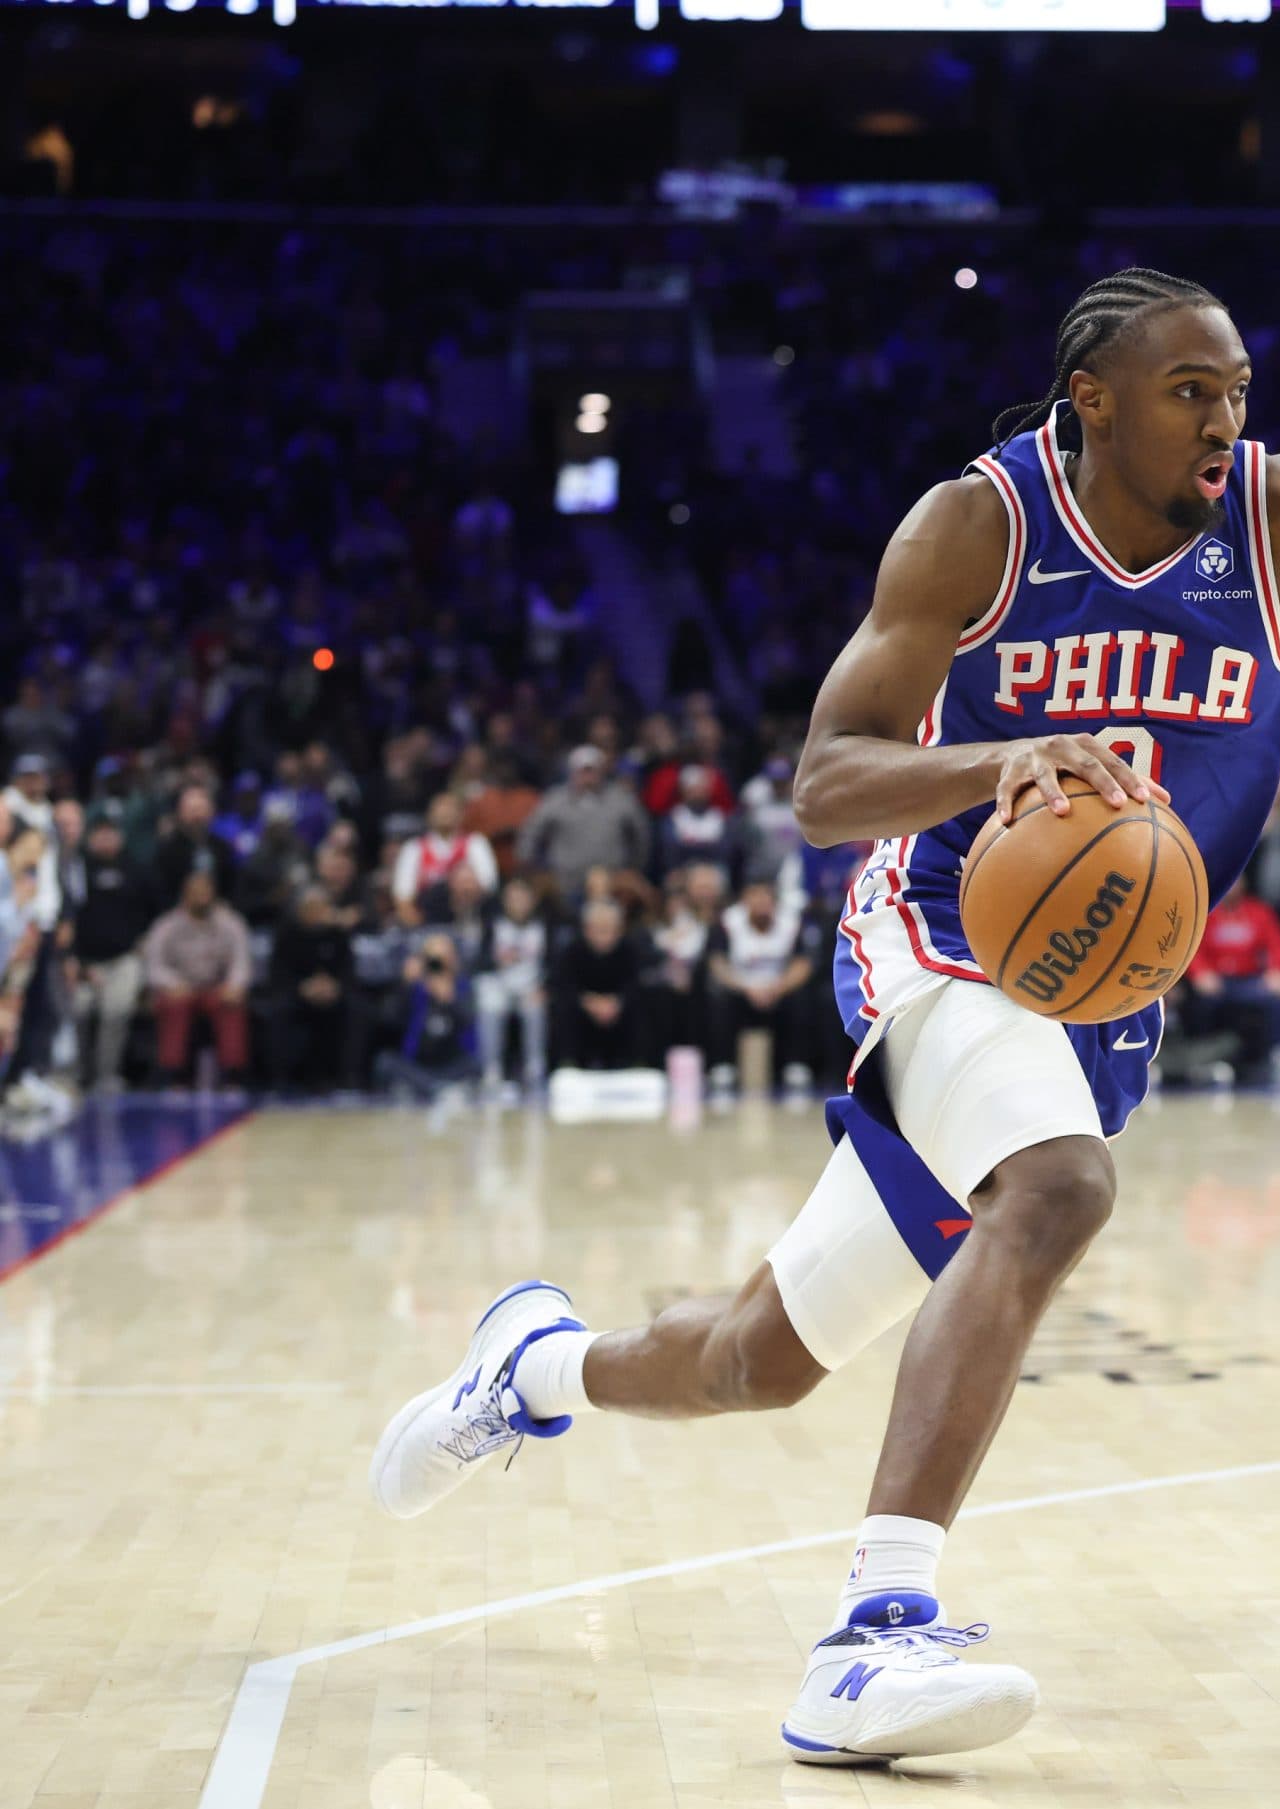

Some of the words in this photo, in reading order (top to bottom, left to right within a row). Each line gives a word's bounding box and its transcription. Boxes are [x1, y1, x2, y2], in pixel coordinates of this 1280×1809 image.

[1182, 588, 1253, 602] crypto.com
[994, 630, 1259, 724] PHILA
[1014, 871, 1136, 1003] Wilson
[830, 1661, 886, 1701] N
